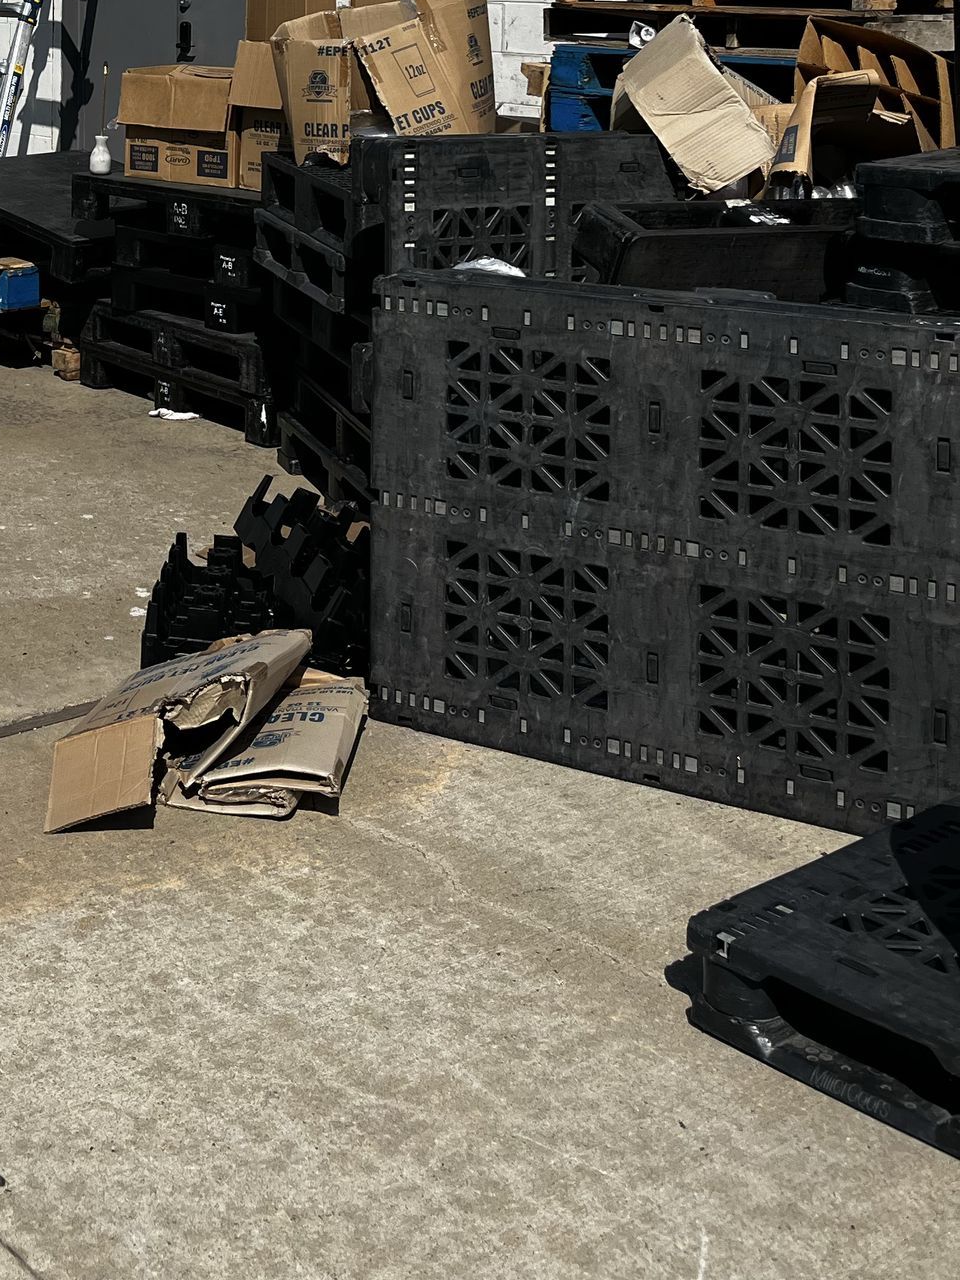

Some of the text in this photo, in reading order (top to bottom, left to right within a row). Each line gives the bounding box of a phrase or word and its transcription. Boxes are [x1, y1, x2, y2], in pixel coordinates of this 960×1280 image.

[404, 64, 427, 80] 12oz
[411, 100, 446, 124] CUPS
[304, 122, 338, 138] CLEAR
[167, 156, 187, 164] DART
[173, 202, 188, 215] A-B
[221, 261, 233, 270] A-B
[809, 1068, 889, 1119] MillerCoors
